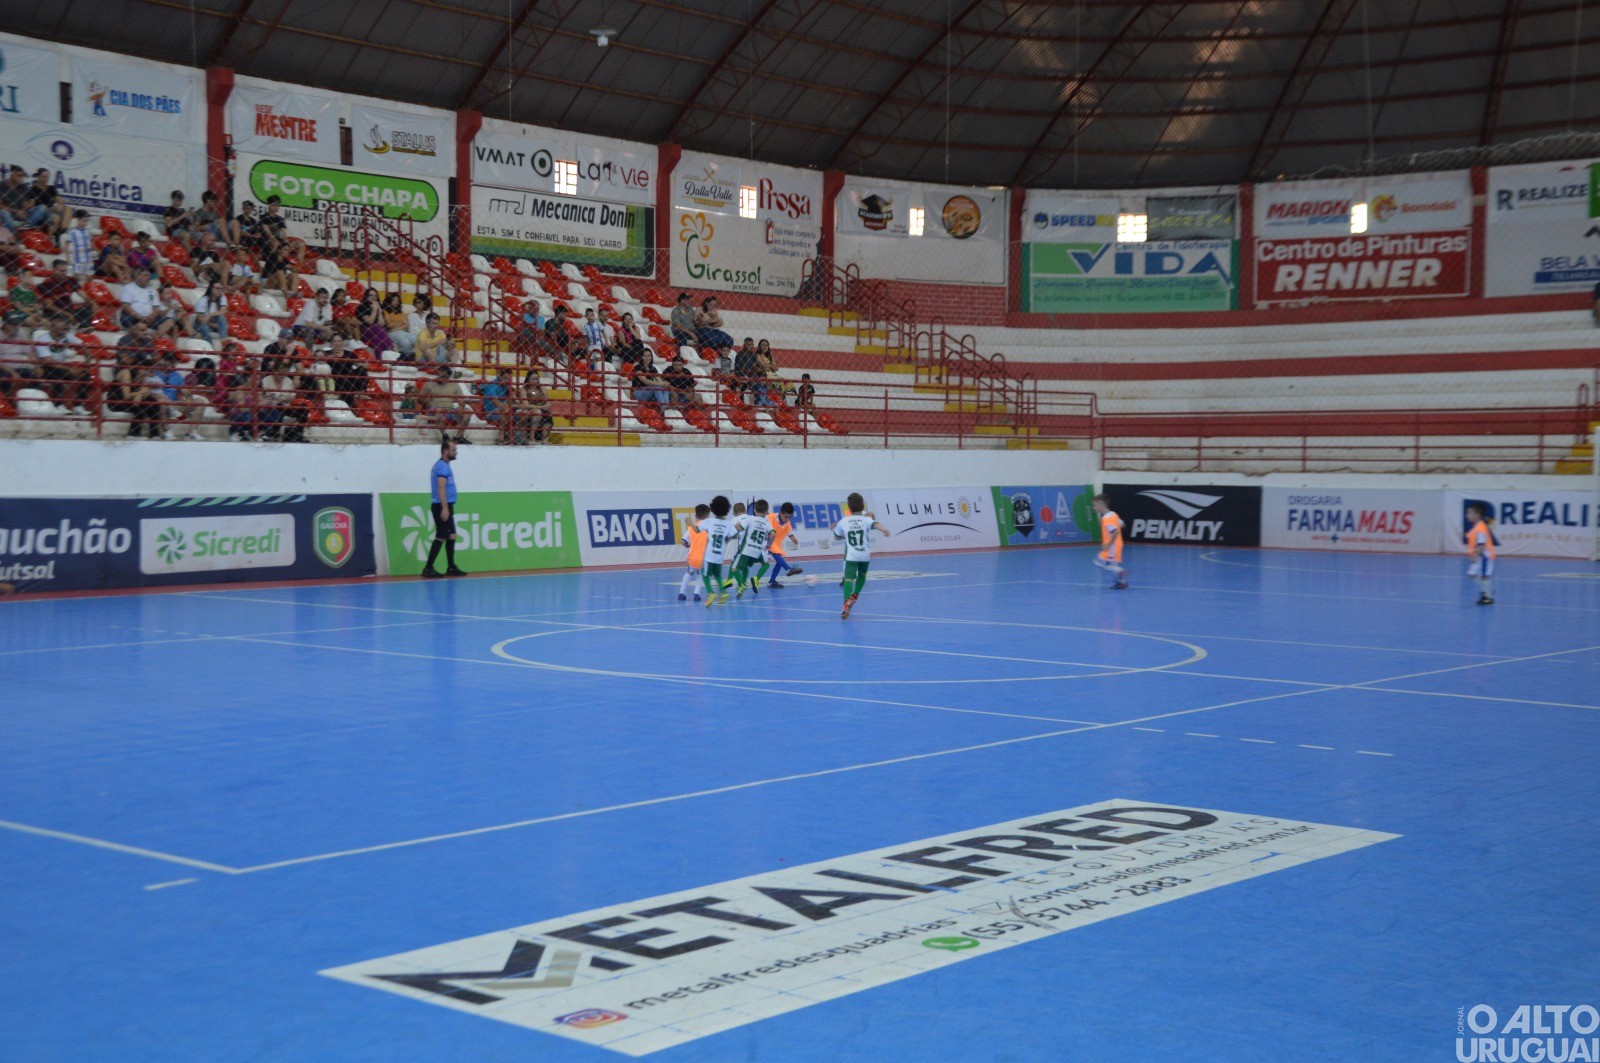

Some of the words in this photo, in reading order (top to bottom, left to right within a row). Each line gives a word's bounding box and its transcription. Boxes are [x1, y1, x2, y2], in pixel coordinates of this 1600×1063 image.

[109, 89, 129, 106] CIA
[131, 93, 153, 110] DOS
[155, 95, 182, 114] PÃES
[255, 112, 317, 142] MESTRE
[391, 130, 437, 151] STALUS
[54, 169, 143, 202] América
[621, 166, 649, 187] Vie
[263, 172, 335, 199] FOTO
[345, 183, 429, 210] CHAPA
[1517, 182, 1589, 201] REALIZE
[600, 204, 635, 229] Donin
[1051, 214, 1096, 228] SPEED
[1266, 199, 1352, 219] MARION
[477, 225, 496, 236] ESTA
[562, 235, 580, 245] PARA
[583, 237, 596, 247] SEU
[600, 239, 622, 250] CARRO
[1257, 238, 1336, 263] Centro
[1337, 237, 1366, 258] de
[1366, 234, 1469, 257] Pinturas
[685, 233, 762, 285] Girassol
[1070, 242, 1234, 288] VIDA
[1273, 257, 1443, 293] RENNER
[1286, 495, 1343, 506] DROGARIA
[453, 511, 563, 551] Sicredi
[591, 512, 670, 543] BAKOF
[750, 529, 766, 545] 45
[847, 529, 865, 547] 67
[1130, 518, 1224, 541] PENALTY
[191, 527, 282, 558] Sicredi
[0, 560, 56, 581] utsal
